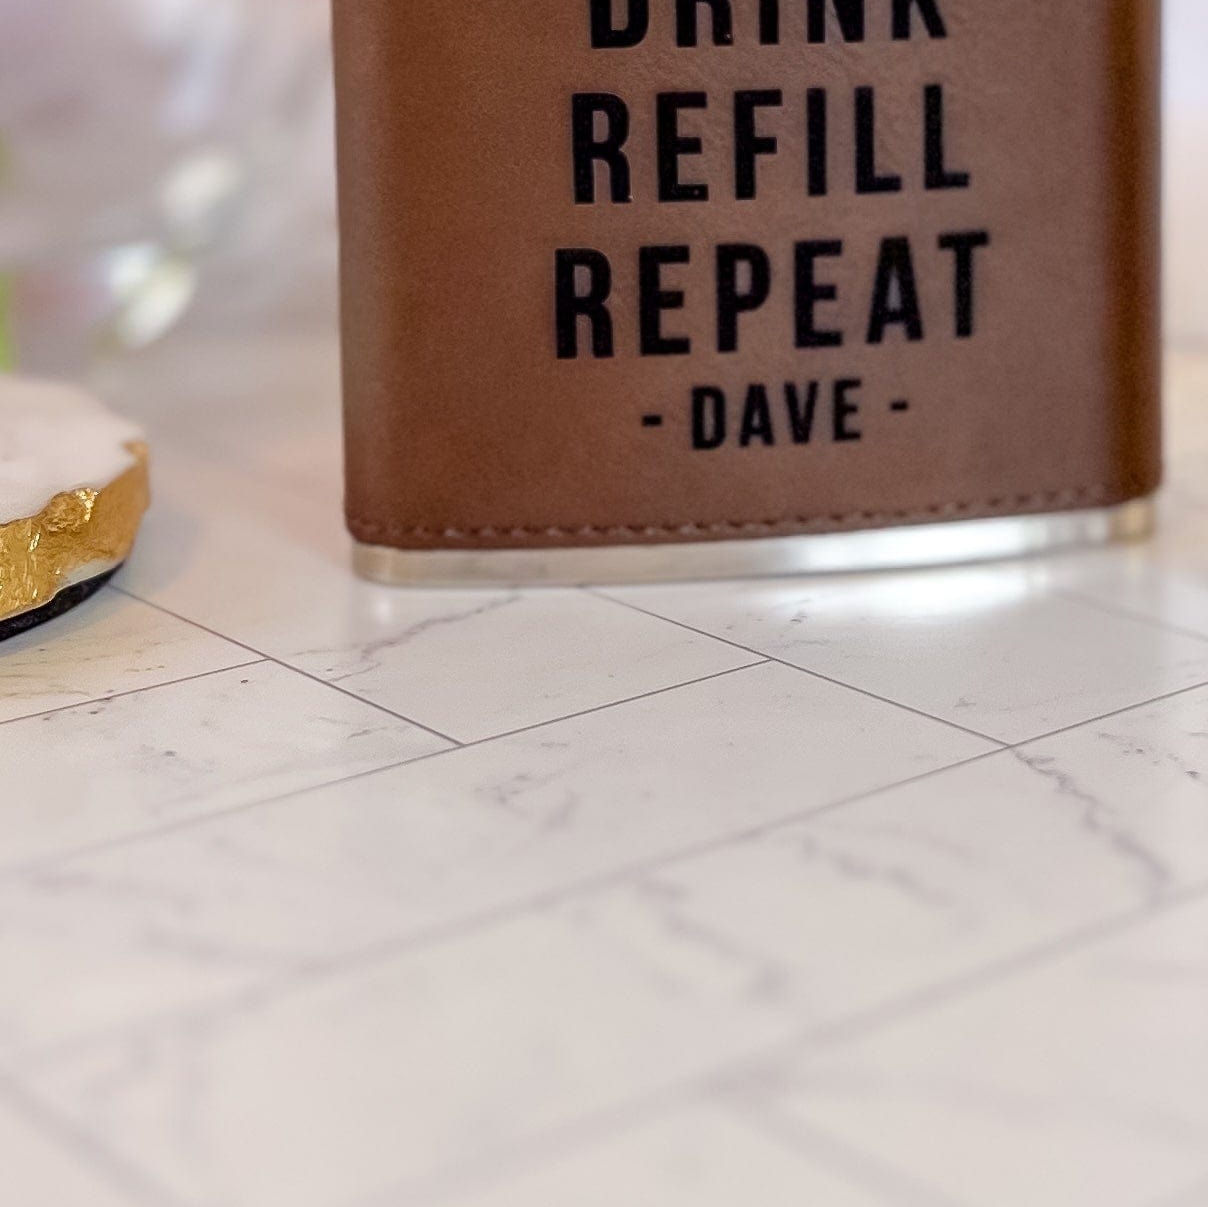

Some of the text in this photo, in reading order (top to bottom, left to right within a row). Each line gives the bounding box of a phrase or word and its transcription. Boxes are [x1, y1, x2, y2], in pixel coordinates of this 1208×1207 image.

[570, 83, 970, 204] REFILL
[553, 230, 990, 360] REPEAT
[688, 376, 864, 453] DAVE
